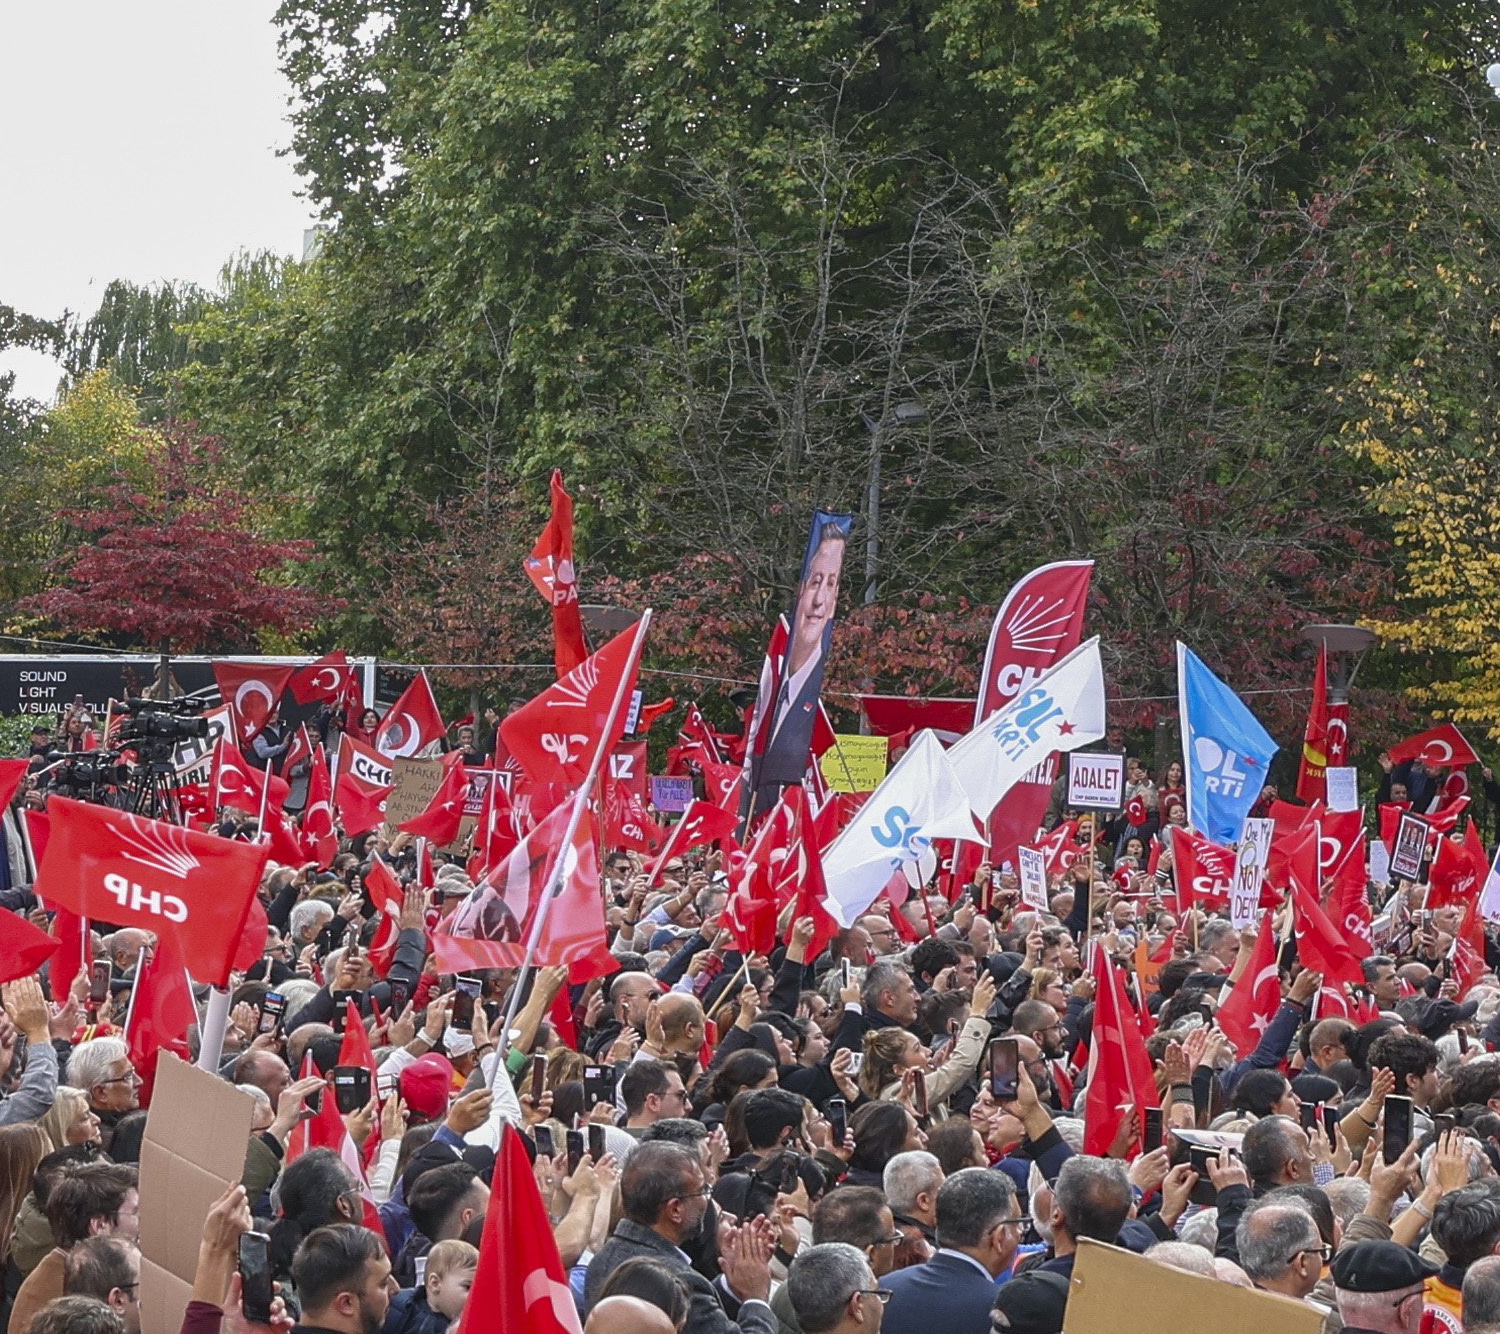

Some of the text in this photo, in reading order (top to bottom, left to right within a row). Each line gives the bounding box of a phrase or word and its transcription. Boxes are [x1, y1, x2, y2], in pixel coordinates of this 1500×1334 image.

[19, 671, 67, 682] SOUND
[998, 664, 1047, 696] CH
[1073, 767, 1119, 790] ADALET
[1192, 876, 1235, 899] CH
[1345, 913, 1372, 942] CH
